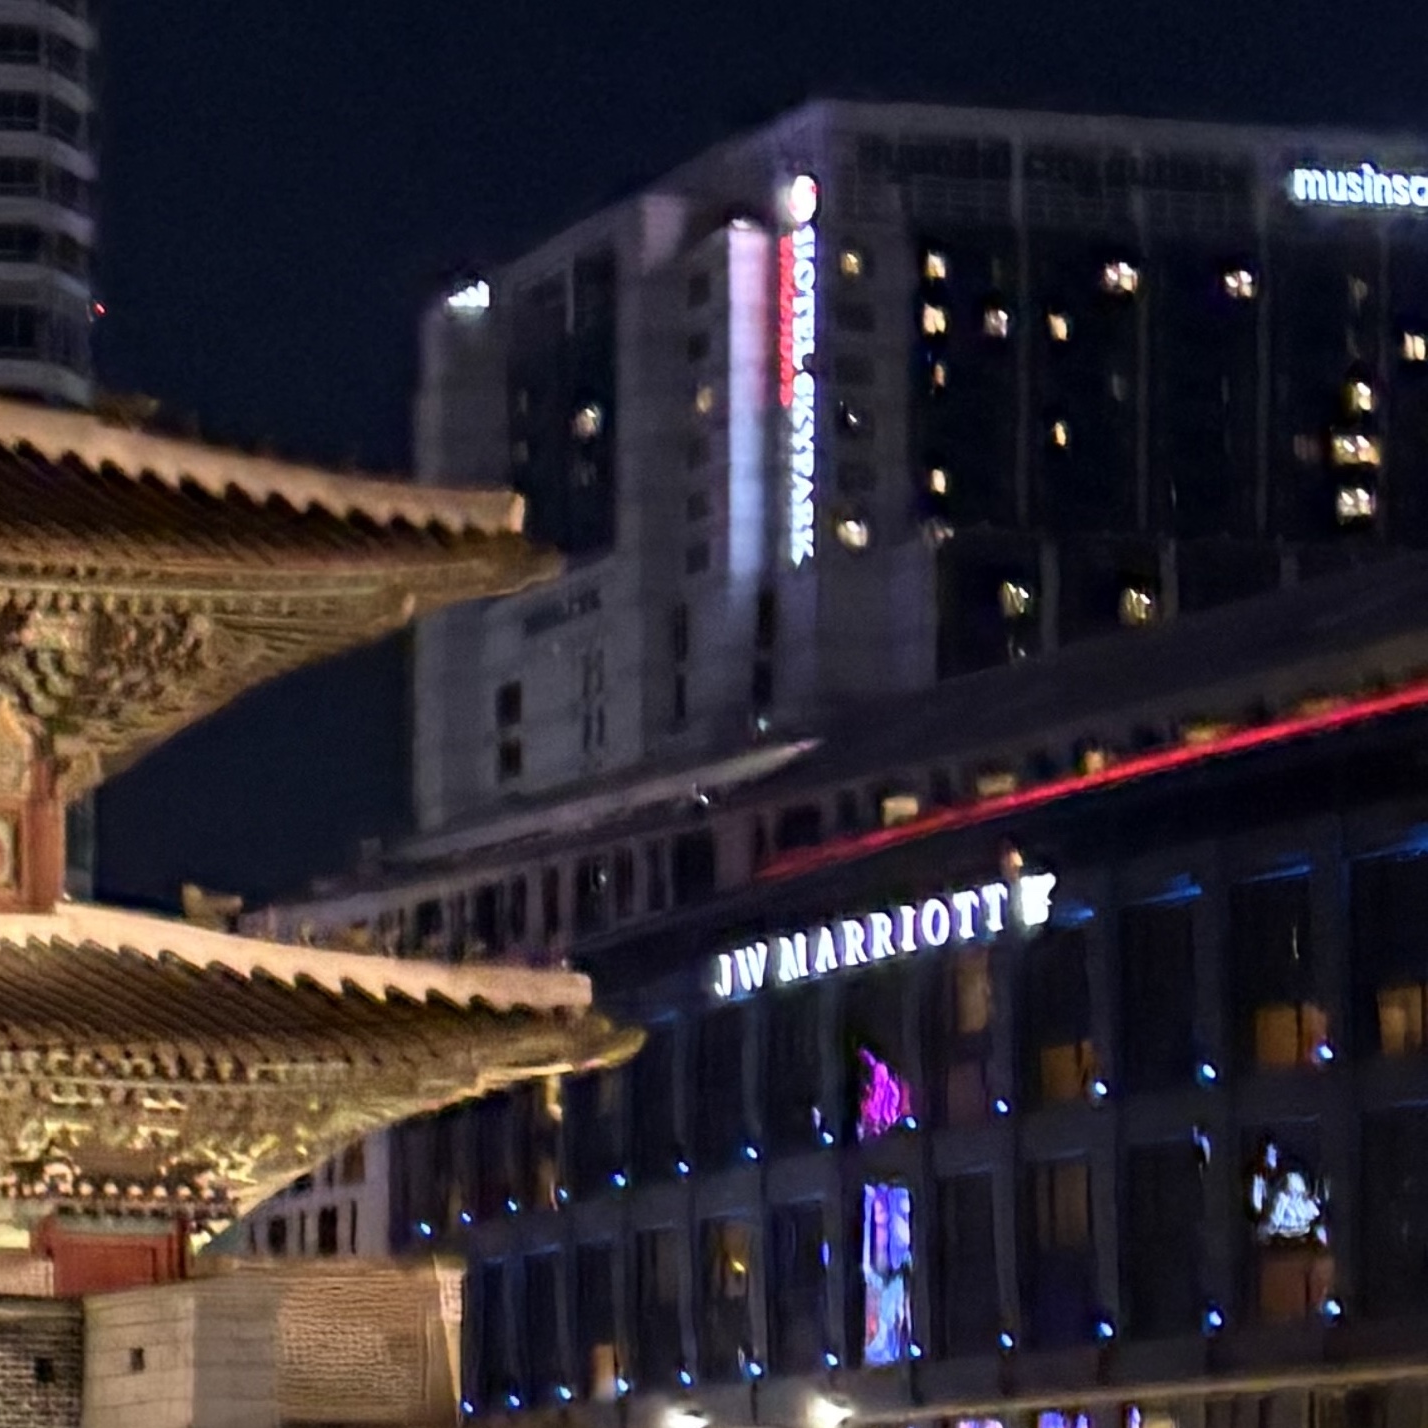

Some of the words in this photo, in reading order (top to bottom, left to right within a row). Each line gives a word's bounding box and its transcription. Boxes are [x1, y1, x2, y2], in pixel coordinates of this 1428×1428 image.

[791, 224, 816, 371] HOTEL
[790, 371, 815, 570] SKYPARK
[714, 941, 768, 997] JW
[778, 882, 1009, 982] MARRIOTT
